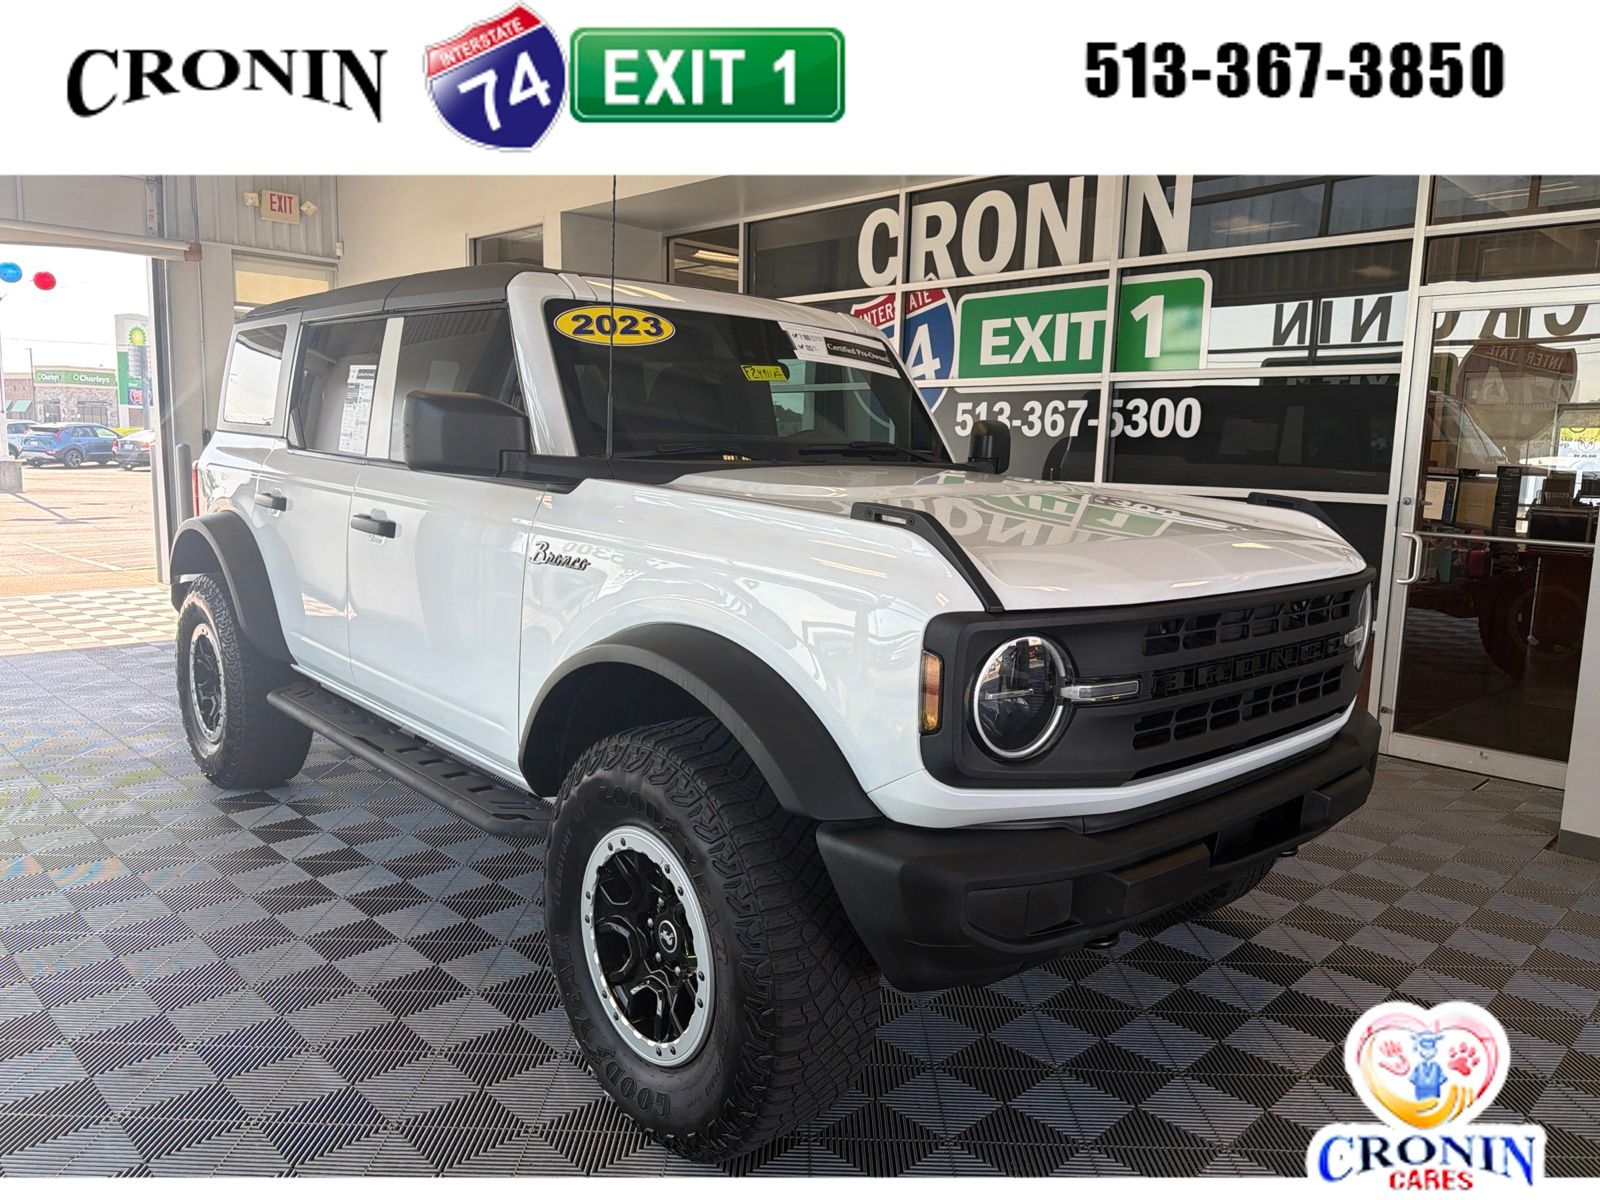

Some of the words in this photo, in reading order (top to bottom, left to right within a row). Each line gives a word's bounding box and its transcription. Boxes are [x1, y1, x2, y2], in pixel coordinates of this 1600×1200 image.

[269, 193, 294, 215] EXIT
[858, 175, 1193, 288] CRONIN
[571, 313, 663, 337] 2023
[979, 310, 1106, 366] EXIT
[1130, 294, 1164, 358] 1
[529, 541, 592, 571] Bronco
[1153, 637, 1344, 691] BRONCO
